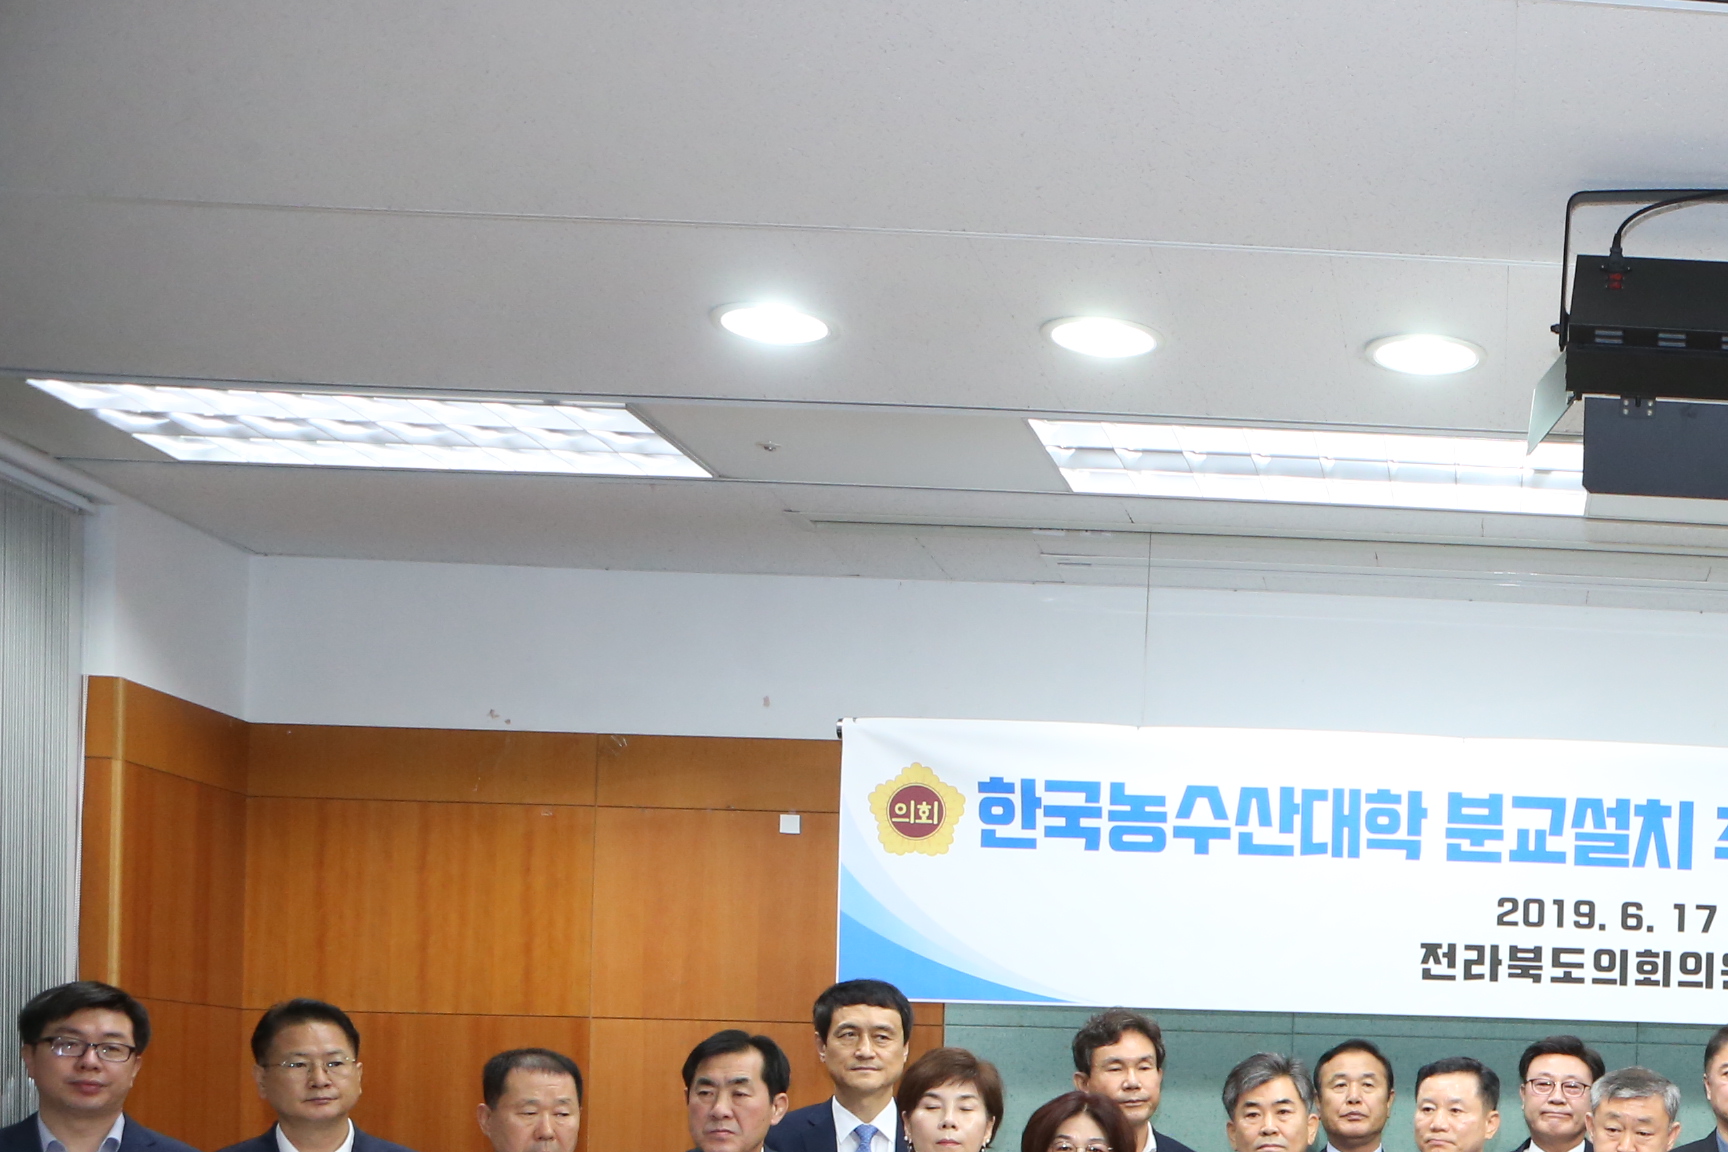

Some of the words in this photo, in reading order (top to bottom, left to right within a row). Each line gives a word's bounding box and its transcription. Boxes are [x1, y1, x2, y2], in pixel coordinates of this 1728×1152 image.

[891, 800, 939, 825] 의회
[978, 777, 1426, 859] 한국농수산대학
[1447, 793, 1693, 869] 분교설치
[1497, 898, 1605, 930] 2019.
[1674, 904, 1716, 933] 17
